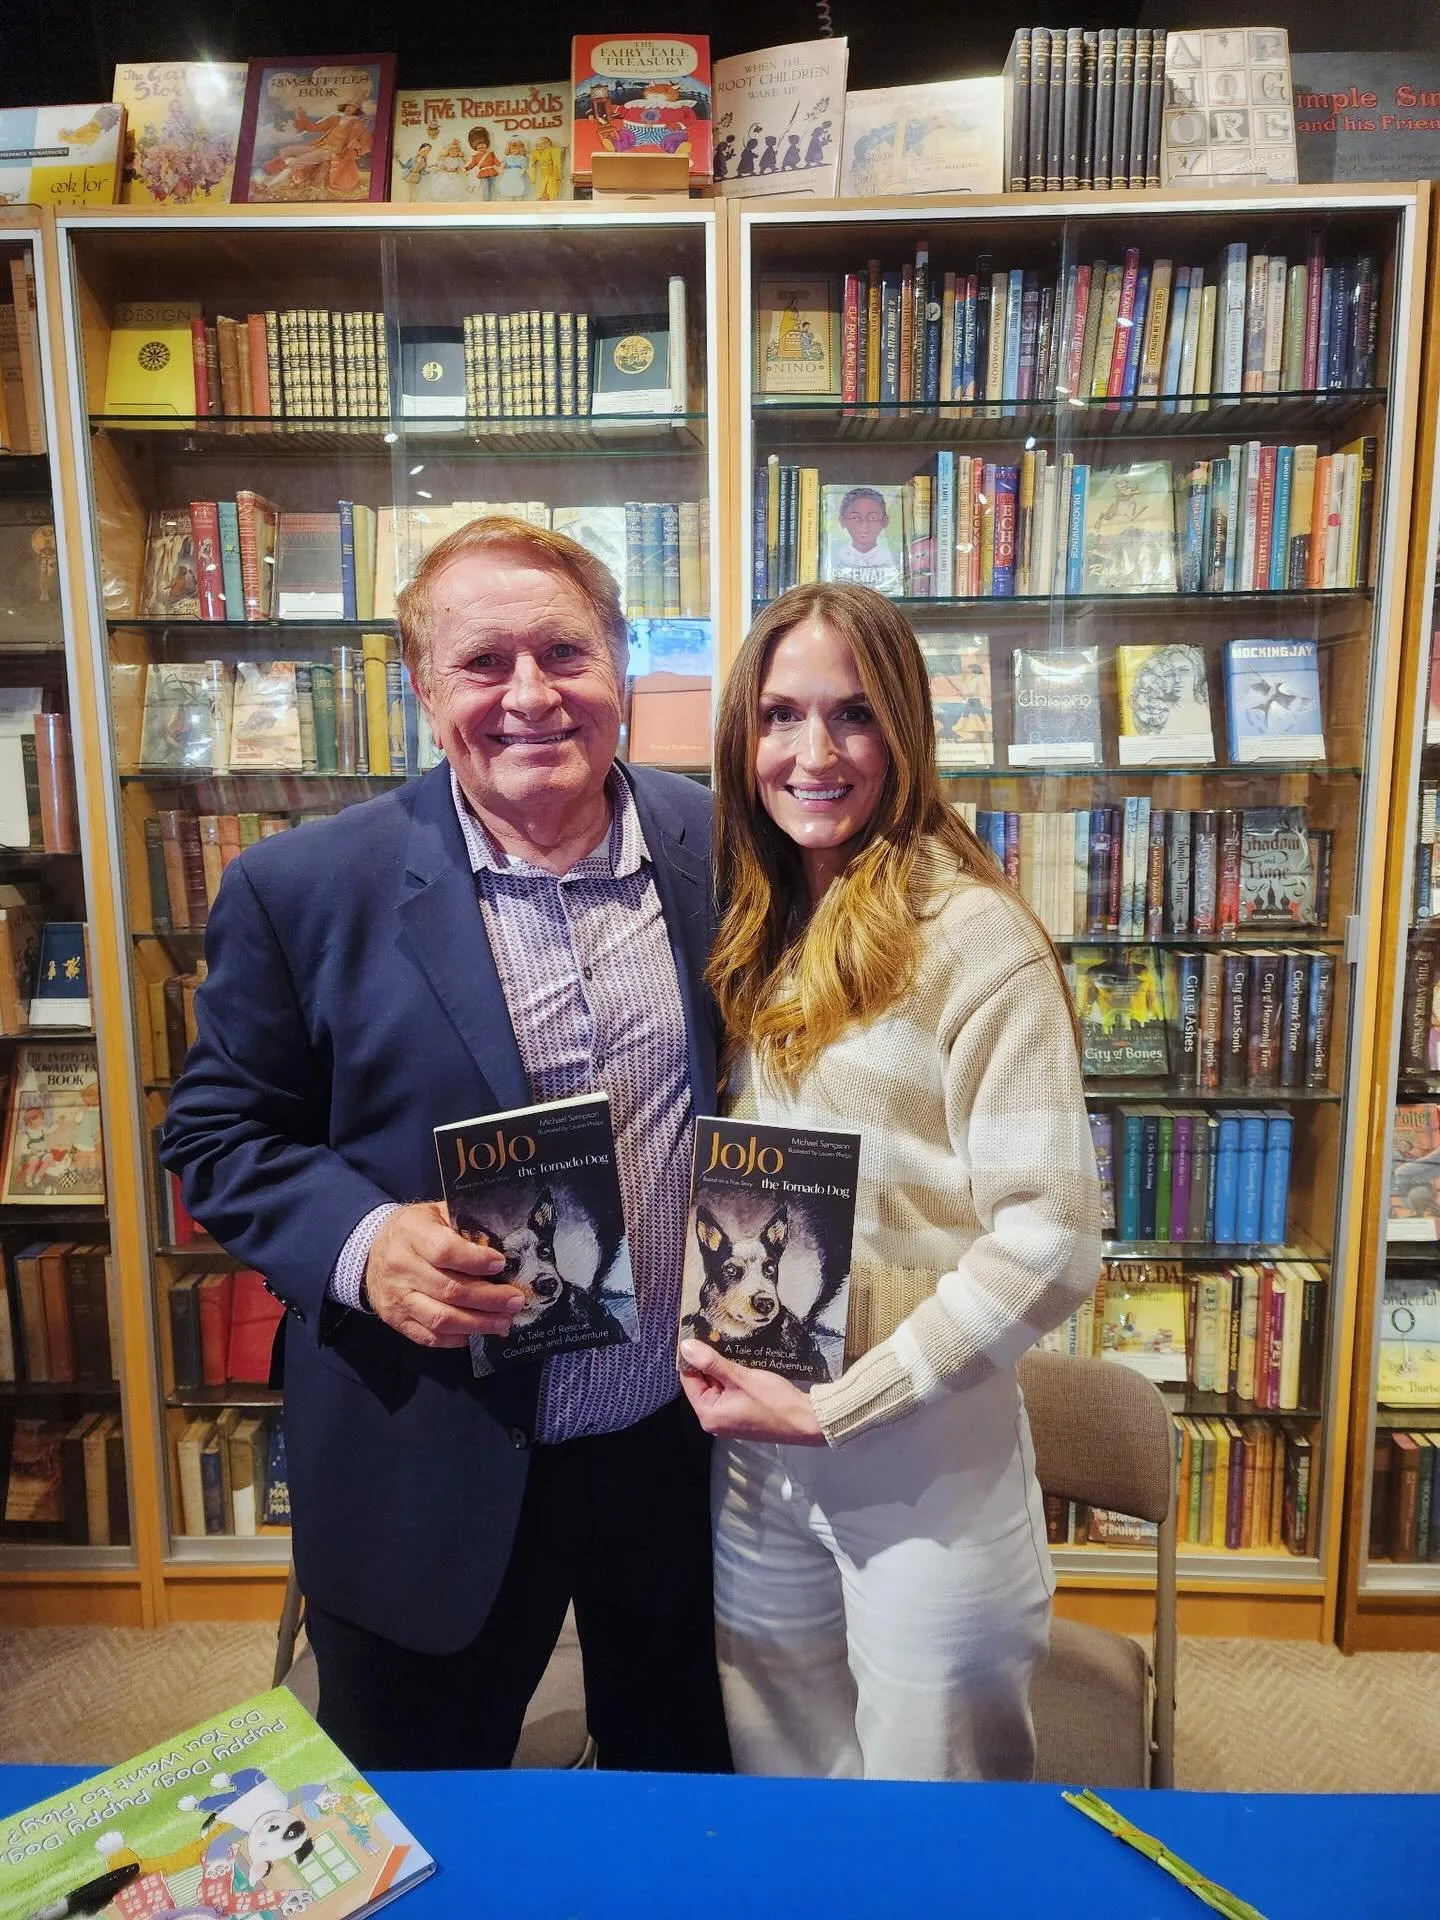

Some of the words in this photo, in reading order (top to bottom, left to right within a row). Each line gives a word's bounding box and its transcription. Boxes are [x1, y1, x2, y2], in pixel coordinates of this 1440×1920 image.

[600, 48, 641, 57] FAIRY
[648, 48, 689, 57] TALE
[603, 57, 684, 66] TREASURY
[744, 61, 777, 73] WHEN
[784, 57, 802, 68] THE
[718, 76, 753, 92] ROOT
[760, 65, 831, 86] CHILDREN
[299, 88, 339, 97] BOOK
[747, 88, 778, 100] WAKE
[1294, 86, 1377, 116] imple
[424, 98, 456, 124] FIVE
[456, 94, 563, 119] REBELLIOUS
[493, 115, 563, 131] DOLLS
[1298, 118, 1337, 132] and
[1344, 115, 1376, 131] his
[1155, 293, 1163, 310] DEAD
[121, 307, 192, 322] DESIGN
[846, 306, 857, 323] ELF
[902, 300, 911, 327] MISS
[994, 302, 1002, 329] WALK
[887, 330, 896, 349] FALLS
[993, 331, 1001, 352] TWO
[1150, 334, 1160, 363] NORVELT
[845, 351, 856, 369] OWL
[901, 328, 911, 376] HICKORY
[845, 370, 856, 391] HEAD
[887, 363, 896, 383] EARTH
[991, 355, 1000, 388] MOONS
[1000, 504, 1014, 556] ECHO
[1070, 494, 1081, 559] DRAGONWINGS
[1231, 646, 1313, 659] MOCKINGJAY
[1018, 689, 1092, 708] Unicorn
[1182, 975, 1198, 1002] City
[1232, 972, 1245, 993] City
[1262, 973, 1275, 995] City
[1319, 974, 1329, 990] The
[1291, 970, 1304, 1018] Clockwork
[1233, 1005, 1243, 1026] Lost
[1184, 1014, 1197, 1053] Ashes
[1260, 1007, 1273, 1049] Heavenly
[1290, 1019, 1301, 1052] Prince
[1231, 1027, 1242, 1053] Souls
[1315, 1012, 1328, 1069] Chronicles
[1084, 1048, 1111, 1063] City
[1113, 1048, 1123, 1059] of
[1126, 1047, 1163, 1059] Bones
[1205, 1035, 1216, 1067] Angels
[1260, 1050, 1271, 1068] Fire
[47, 1074, 84, 1086] BOOK
[539, 1113, 567, 1127] Michael
[567, 1110, 600, 1124] Sampson
[791, 1136, 817, 1148] Michael
[819, 1139, 850, 1151] Sampson
[455, 1130, 536, 1181] JoJo
[702, 1132, 784, 1177] JoJo
[517, 1164, 537, 1179] the
[538, 1156, 586, 1175] Tornado
[587, 1153, 609, 1167] Dog
[761, 1178, 780, 1191] the
[782, 1180, 826, 1196] Tornado
[827, 1185, 850, 1199] Dog
[1383, 1292, 1439, 1307] onderful
[1391, 1307, 1415, 1333] O
[502, 1341, 544, 1359] Courage,
[546, 1336, 563, 1347] and
[564, 1328, 609, 1344] Adventure
[517, 1334, 526, 1344] A
[527, 1329, 545, 1342] Tale
[547, 1326, 557, 1338] of
[558, 1322, 592, 1336] Rescue,
[725, 1344, 734, 1353] A
[734, 1345, 752, 1355] Tale
[754, 1346, 763, 1356] of
[765, 1349, 798, 1360] Rescue,
[750, 1357, 767, 1368] and
[768, 1358, 814, 1373] Adventure
[229, 1710, 265, 1729] Do
[185, 1727, 230, 1751] You
[211, 1718, 287, 1761] Puppy
[115, 1751, 183, 1788] Want
[82, 1785, 114, 1804] to
[67, 1790, 152, 1837] Puppy
